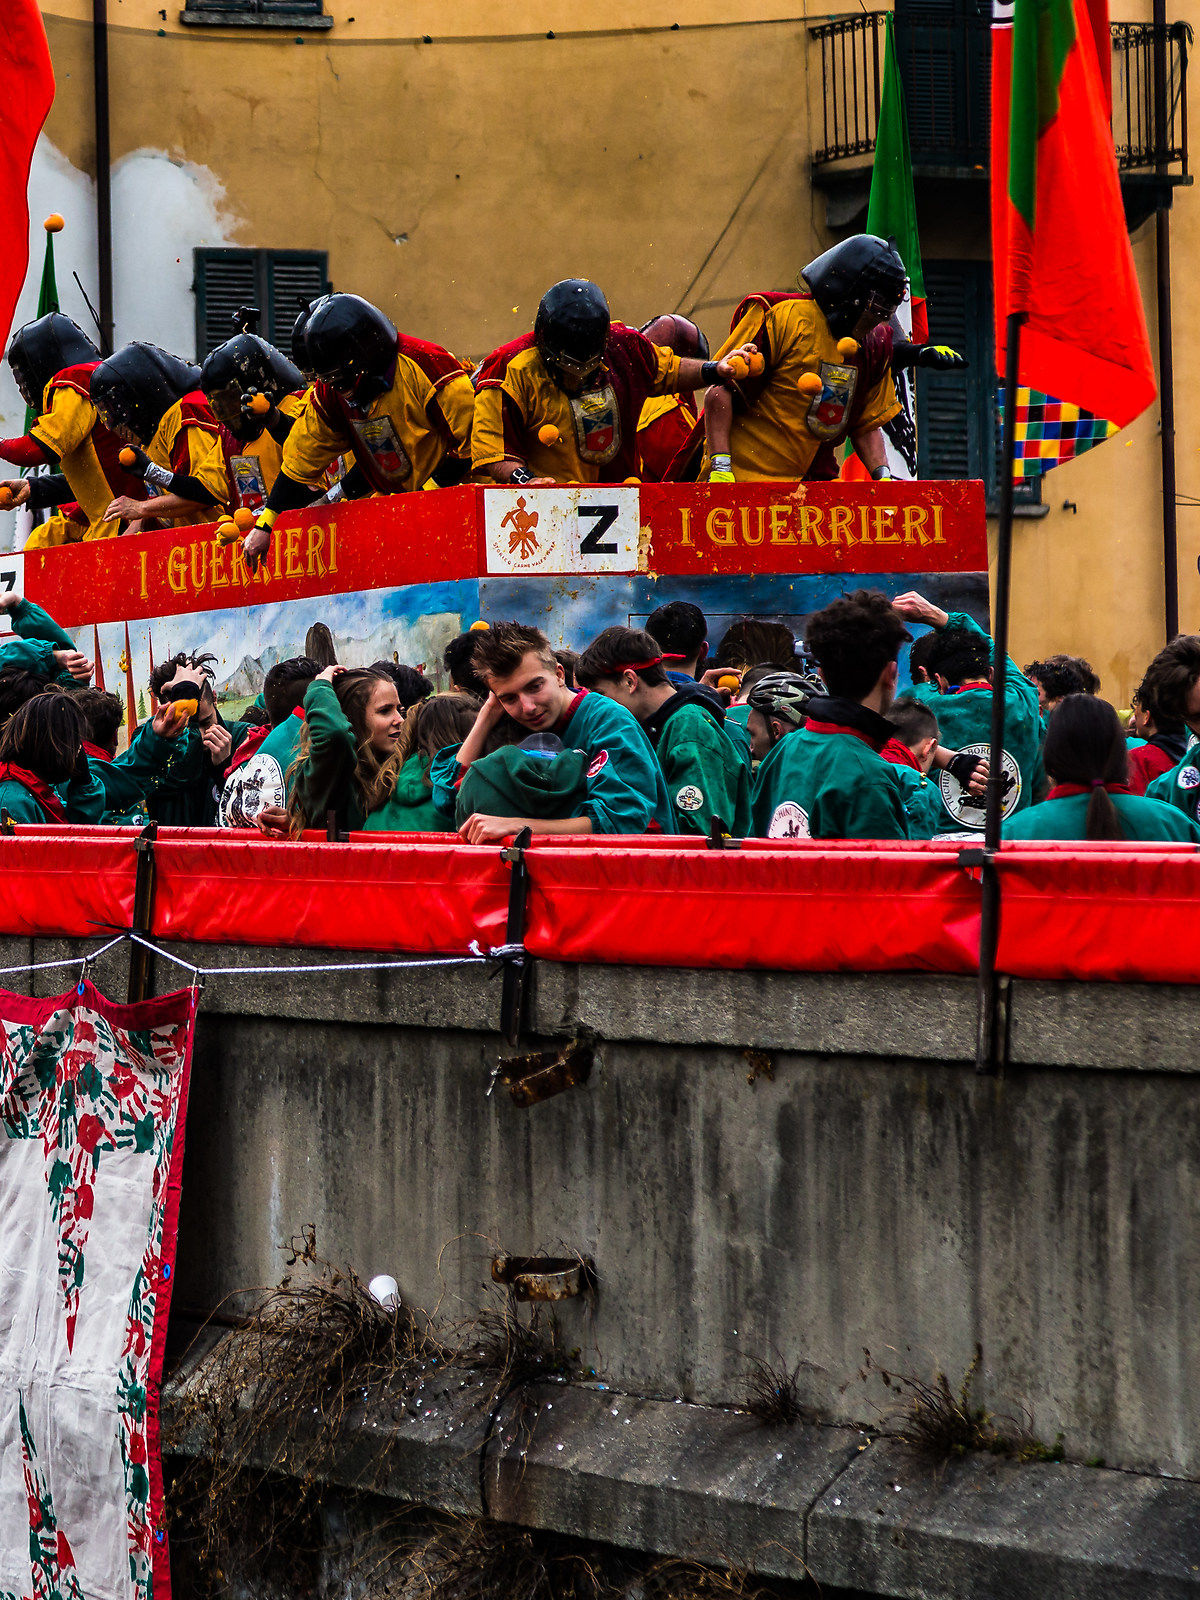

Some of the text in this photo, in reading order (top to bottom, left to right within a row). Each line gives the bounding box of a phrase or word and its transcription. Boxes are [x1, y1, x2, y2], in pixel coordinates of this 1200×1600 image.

[577, 505, 619, 554] Z
[678, 504, 947, 547] I GUERRIERI
[139, 550, 149, 600] I
